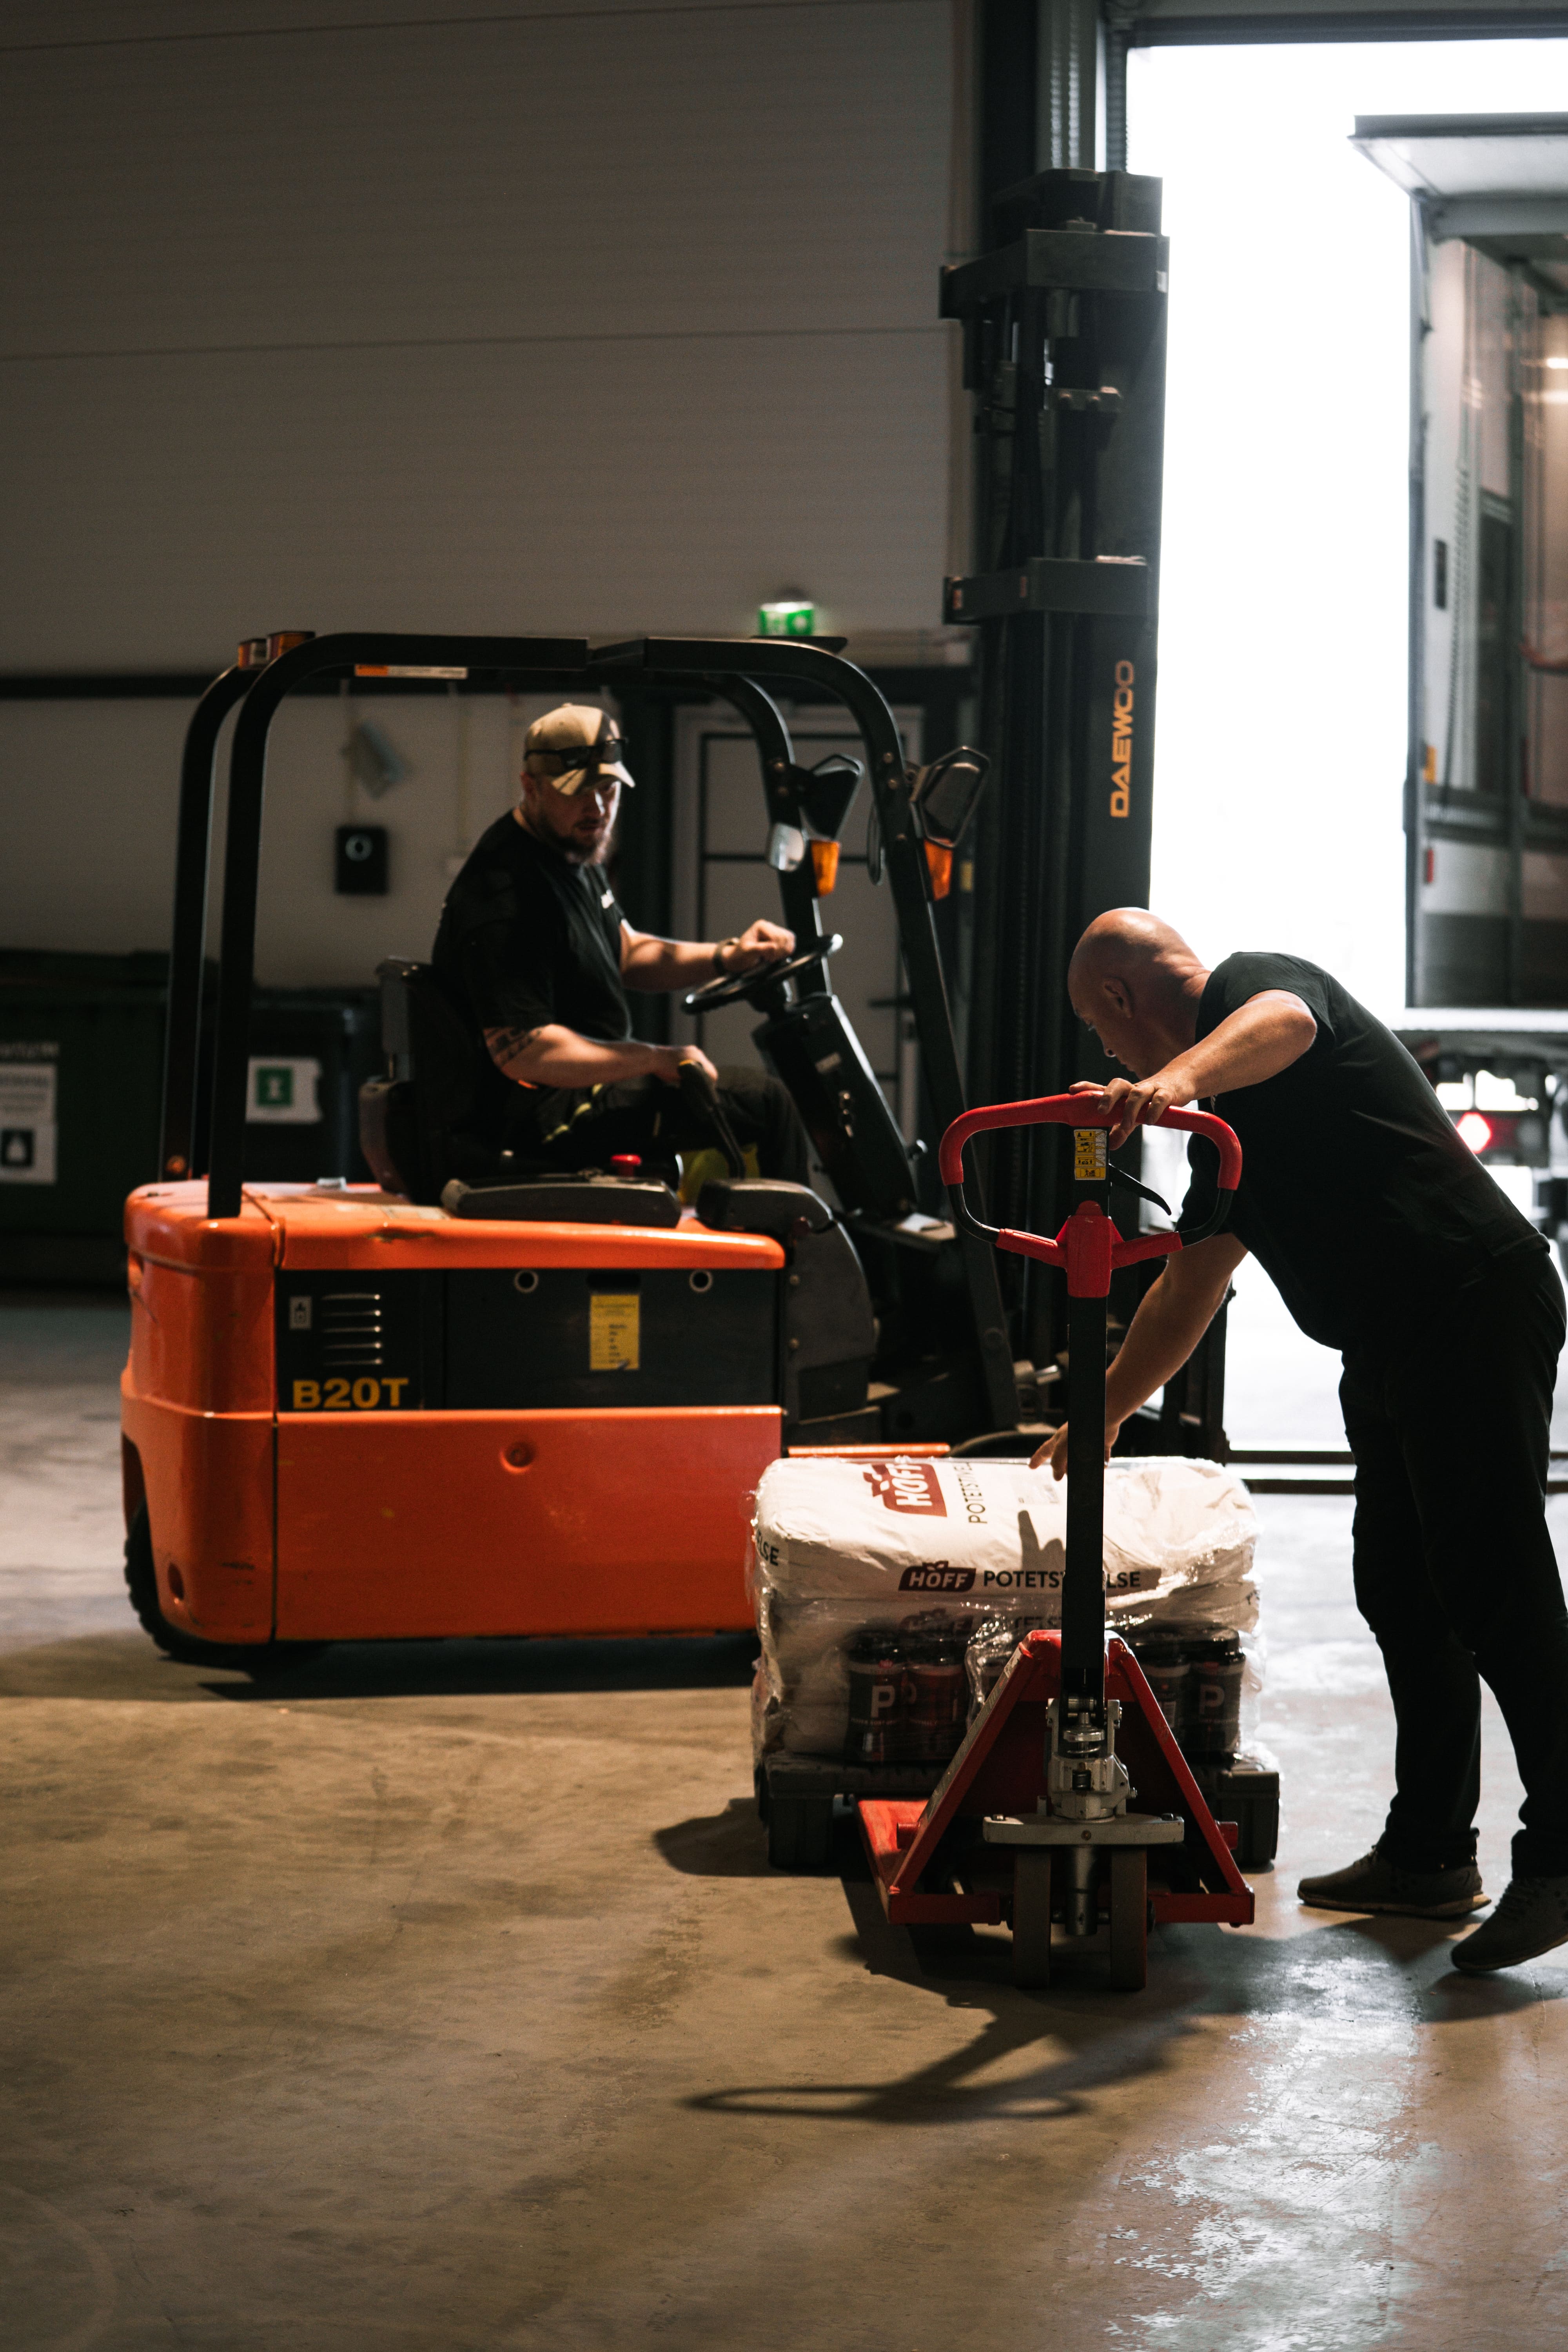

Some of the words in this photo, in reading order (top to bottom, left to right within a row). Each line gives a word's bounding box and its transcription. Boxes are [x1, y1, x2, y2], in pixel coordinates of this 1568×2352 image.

[1110, 660, 1134, 818] DAEWOO
[292, 1376, 410, 1409] B20T
[885, 1463, 932, 1506] HOFF
[953, 1463, 987, 1524] POTETSTIVE
[908, 1570, 969, 1589] HOFF
[984, 1570, 1140, 1588] POTETSLSE
[870, 1685, 895, 1719] P
[1198, 1685, 1225, 1715] P
